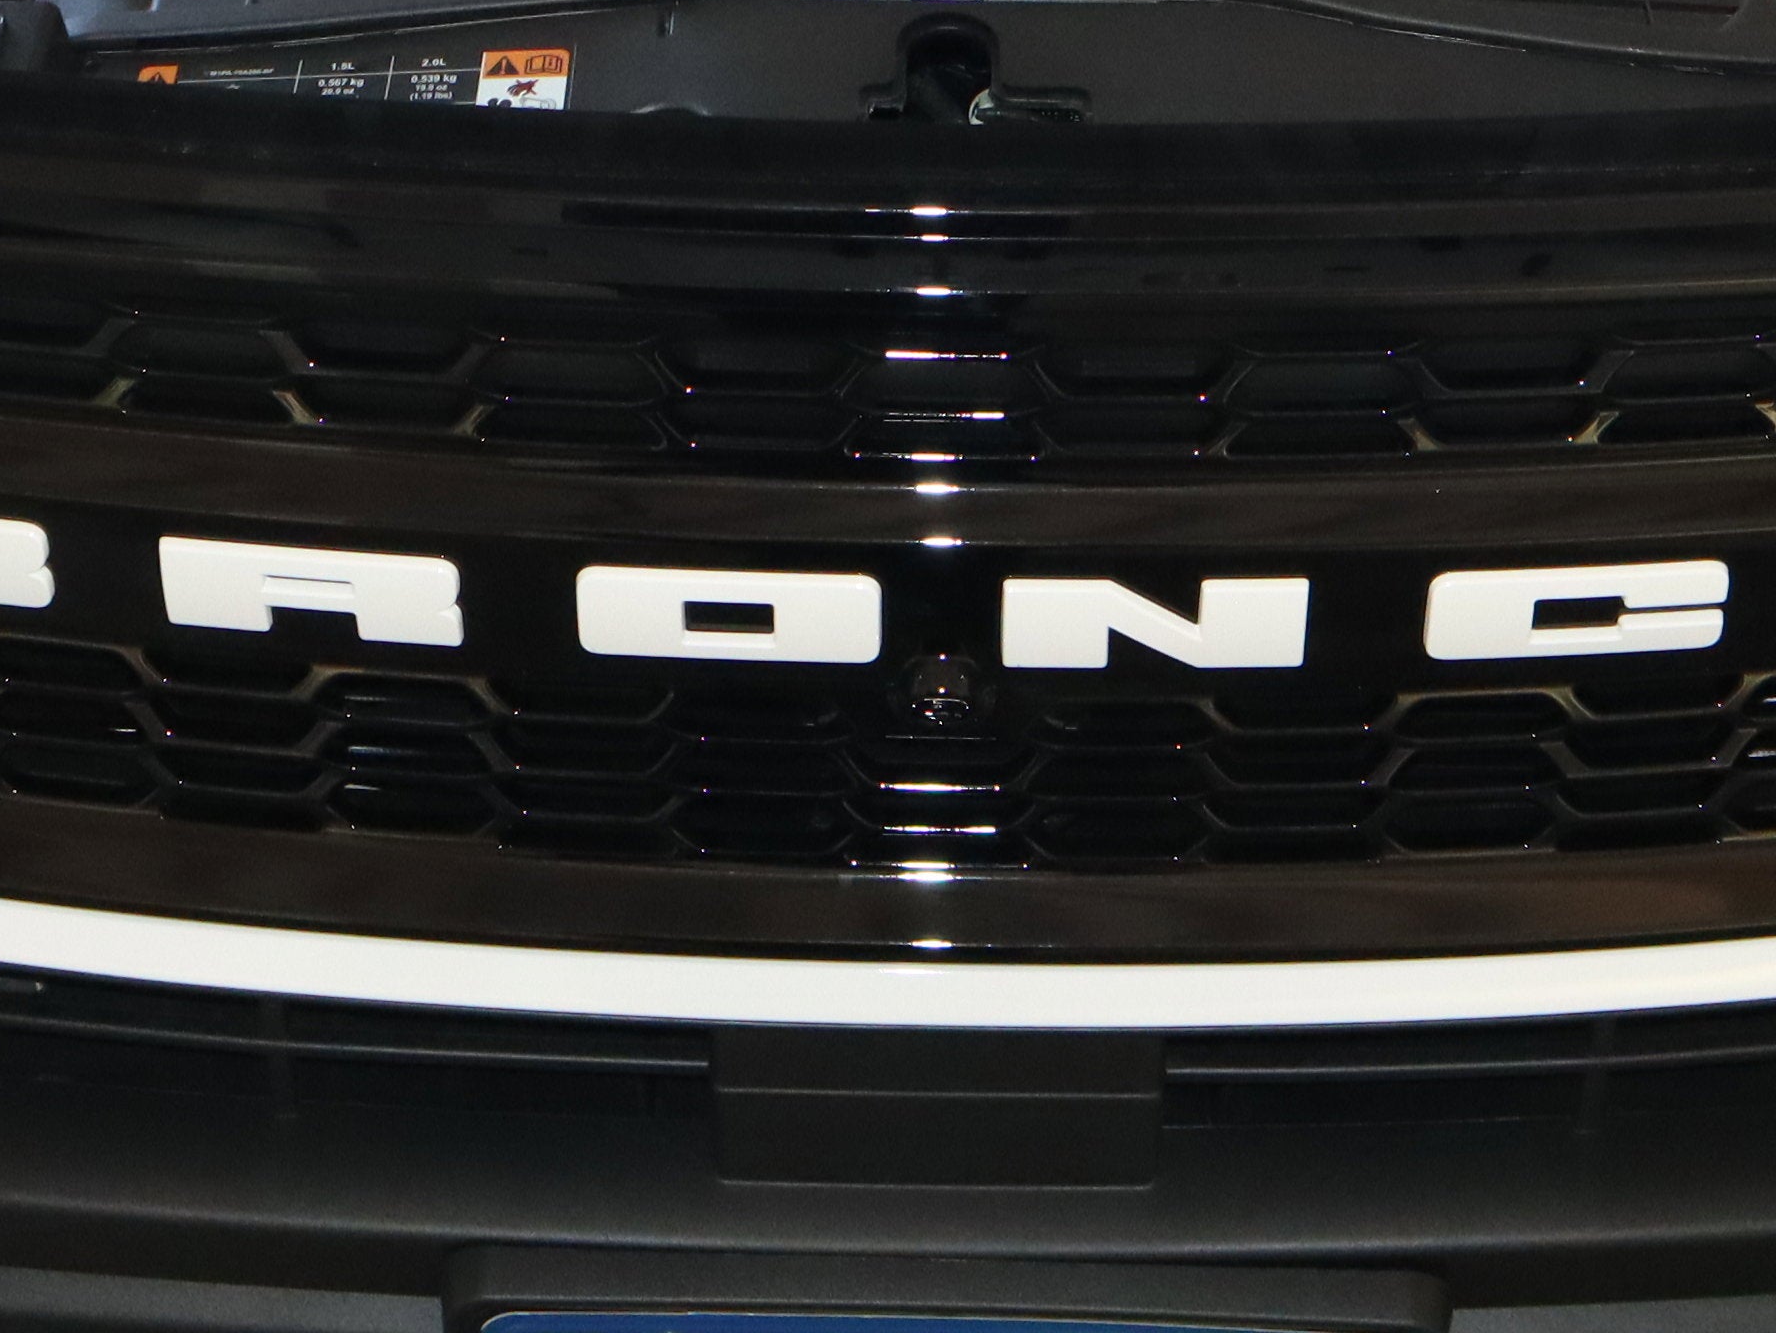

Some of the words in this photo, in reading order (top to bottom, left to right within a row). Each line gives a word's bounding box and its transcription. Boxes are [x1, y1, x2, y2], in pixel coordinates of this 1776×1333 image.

[421, 58, 446, 68] 2.0L
[317, 78, 348, 87] 0.567
[349, 78, 365, 88] kg
[443, 73, 458, 84] kg
